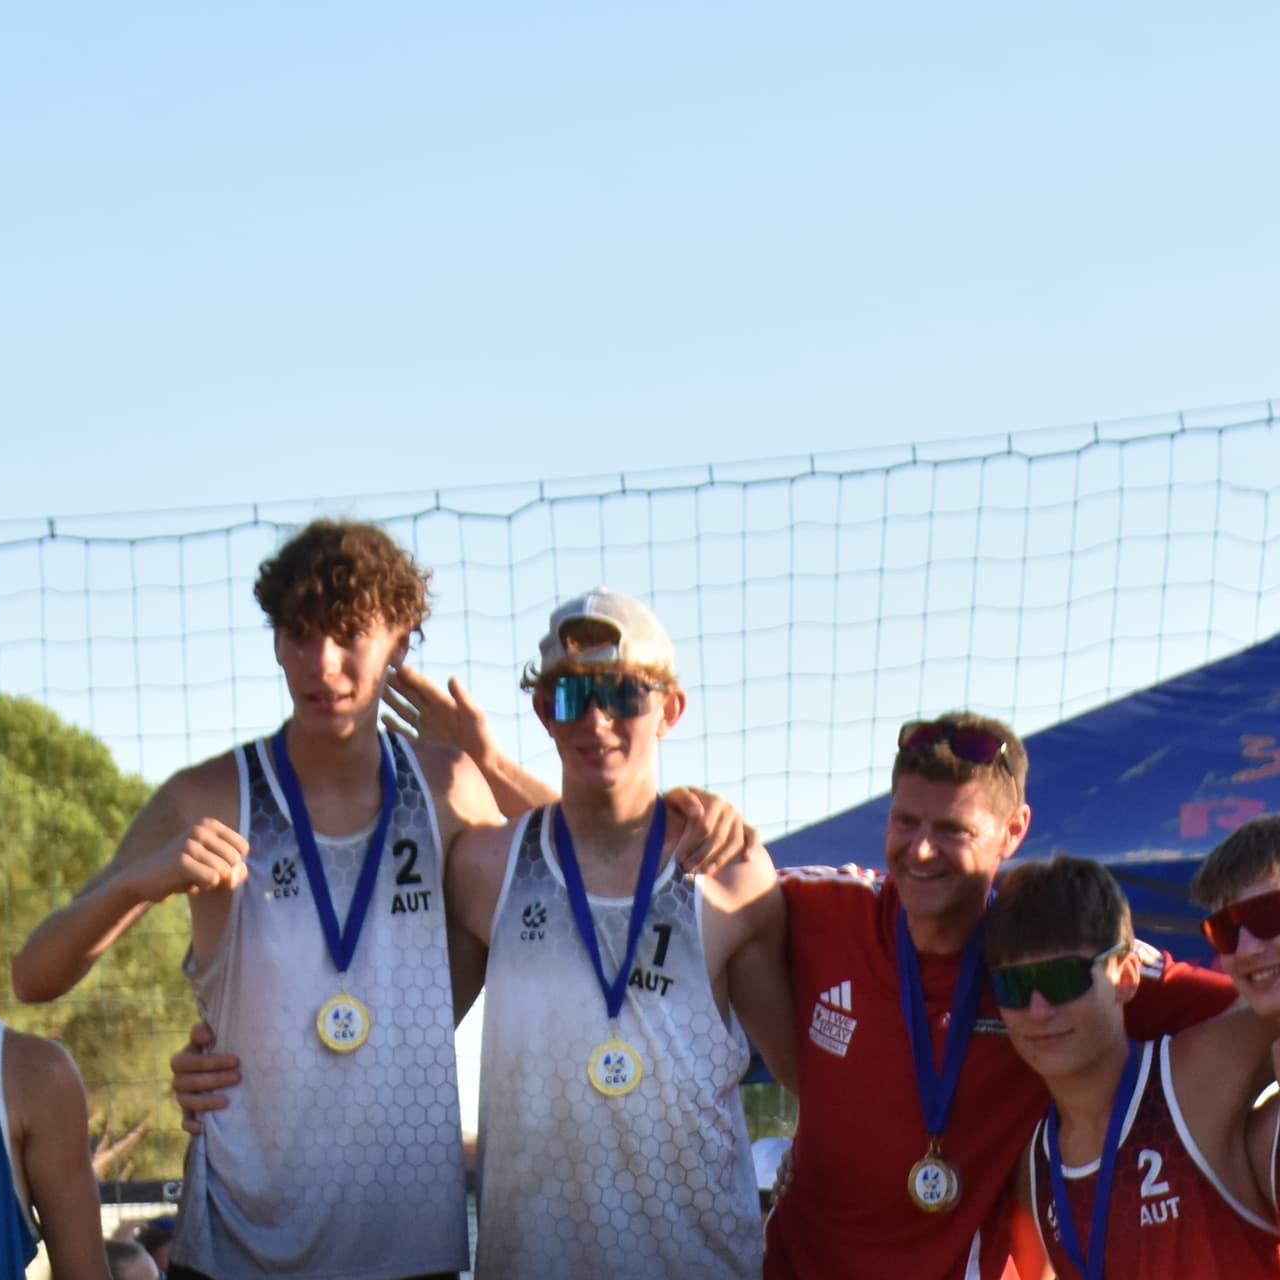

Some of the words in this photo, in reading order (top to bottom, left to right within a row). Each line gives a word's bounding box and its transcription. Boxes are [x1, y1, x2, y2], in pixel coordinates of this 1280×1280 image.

[392, 838, 422, 886] 2
[274, 886, 299, 898] CEV
[391, 891, 431, 914] AUT
[520, 930, 545, 941] CEV
[653, 923, 673, 967] 1
[629, 967, 674, 996] AUT
[334, 1030, 355, 1039] CEV
[605, 1074, 627, 1084] CEV
[1137, 1149, 1171, 1198] 2
[923, 1191, 941, 1200] CEV
[1140, 1197, 1180, 1226] AUT
